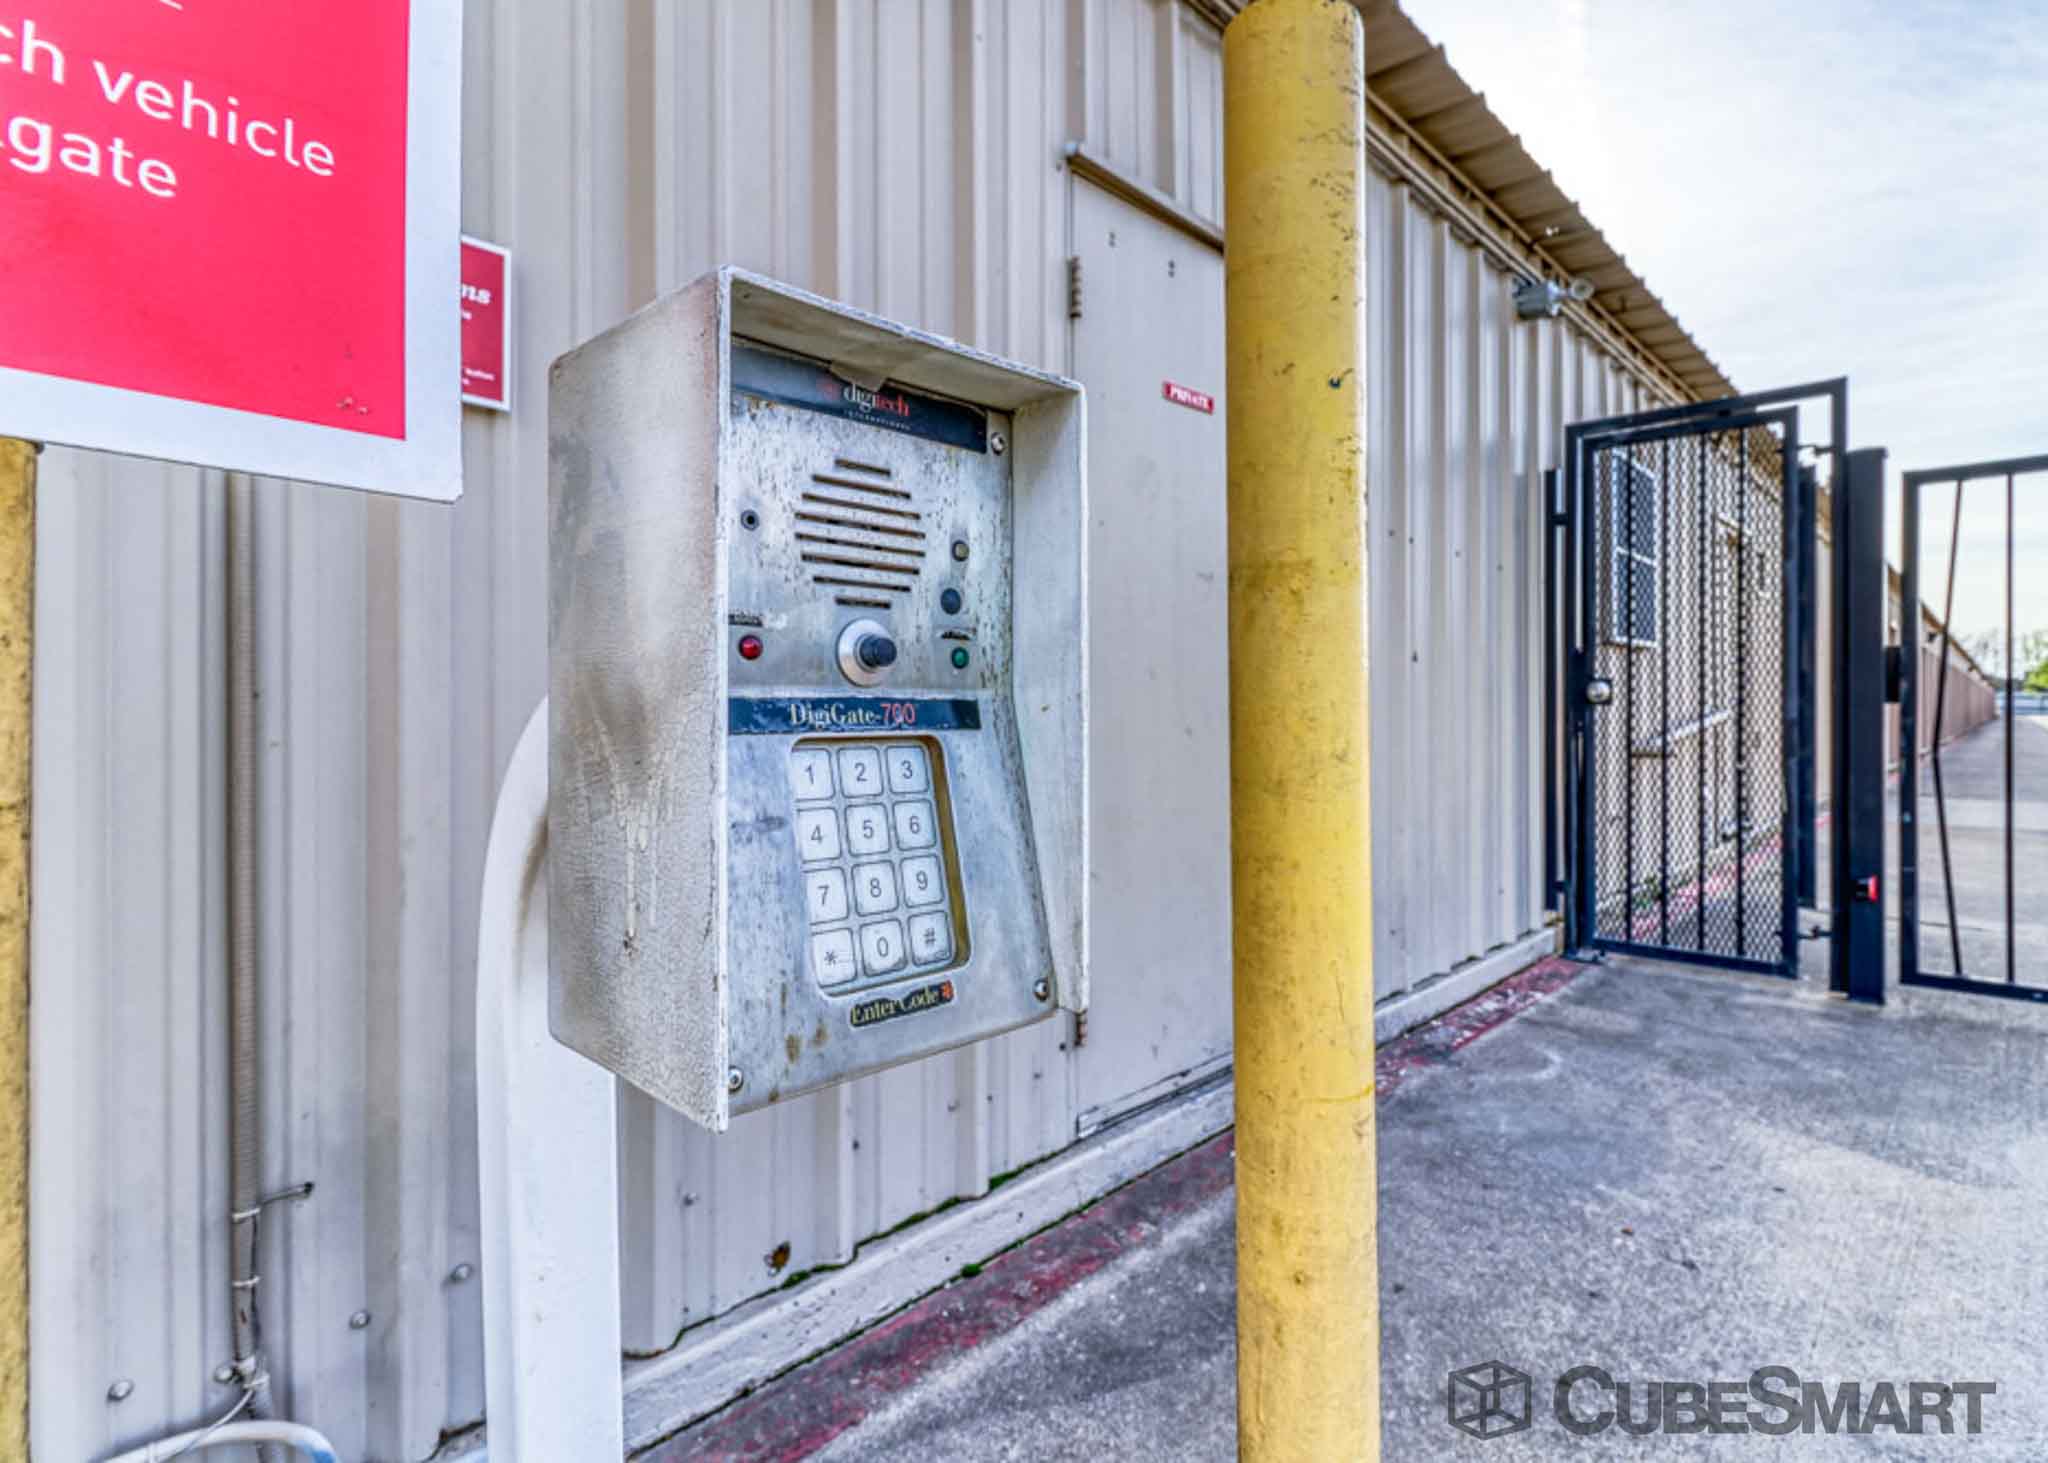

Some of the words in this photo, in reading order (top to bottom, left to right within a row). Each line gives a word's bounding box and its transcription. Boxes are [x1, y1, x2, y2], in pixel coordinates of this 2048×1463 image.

[93, 60, 335, 176] vehicle
[0, 114, 177, 197] gate
[804, 764, 815, 785] 1
[855, 762, 868, 782] 2
[902, 760, 913, 780] 3
[810, 825, 823, 844] 4
[863, 819, 874, 839] 5
[909, 815, 921, 834] 6
[818, 885, 830, 905] 7
[869, 878, 882, 898] 8
[916, 871, 928, 891] 9
[876, 937, 889, 957] 0
[923, 929, 936, 945] #
[851, 1000, 896, 1026] Enter
[897, 986, 939, 1012] Code
